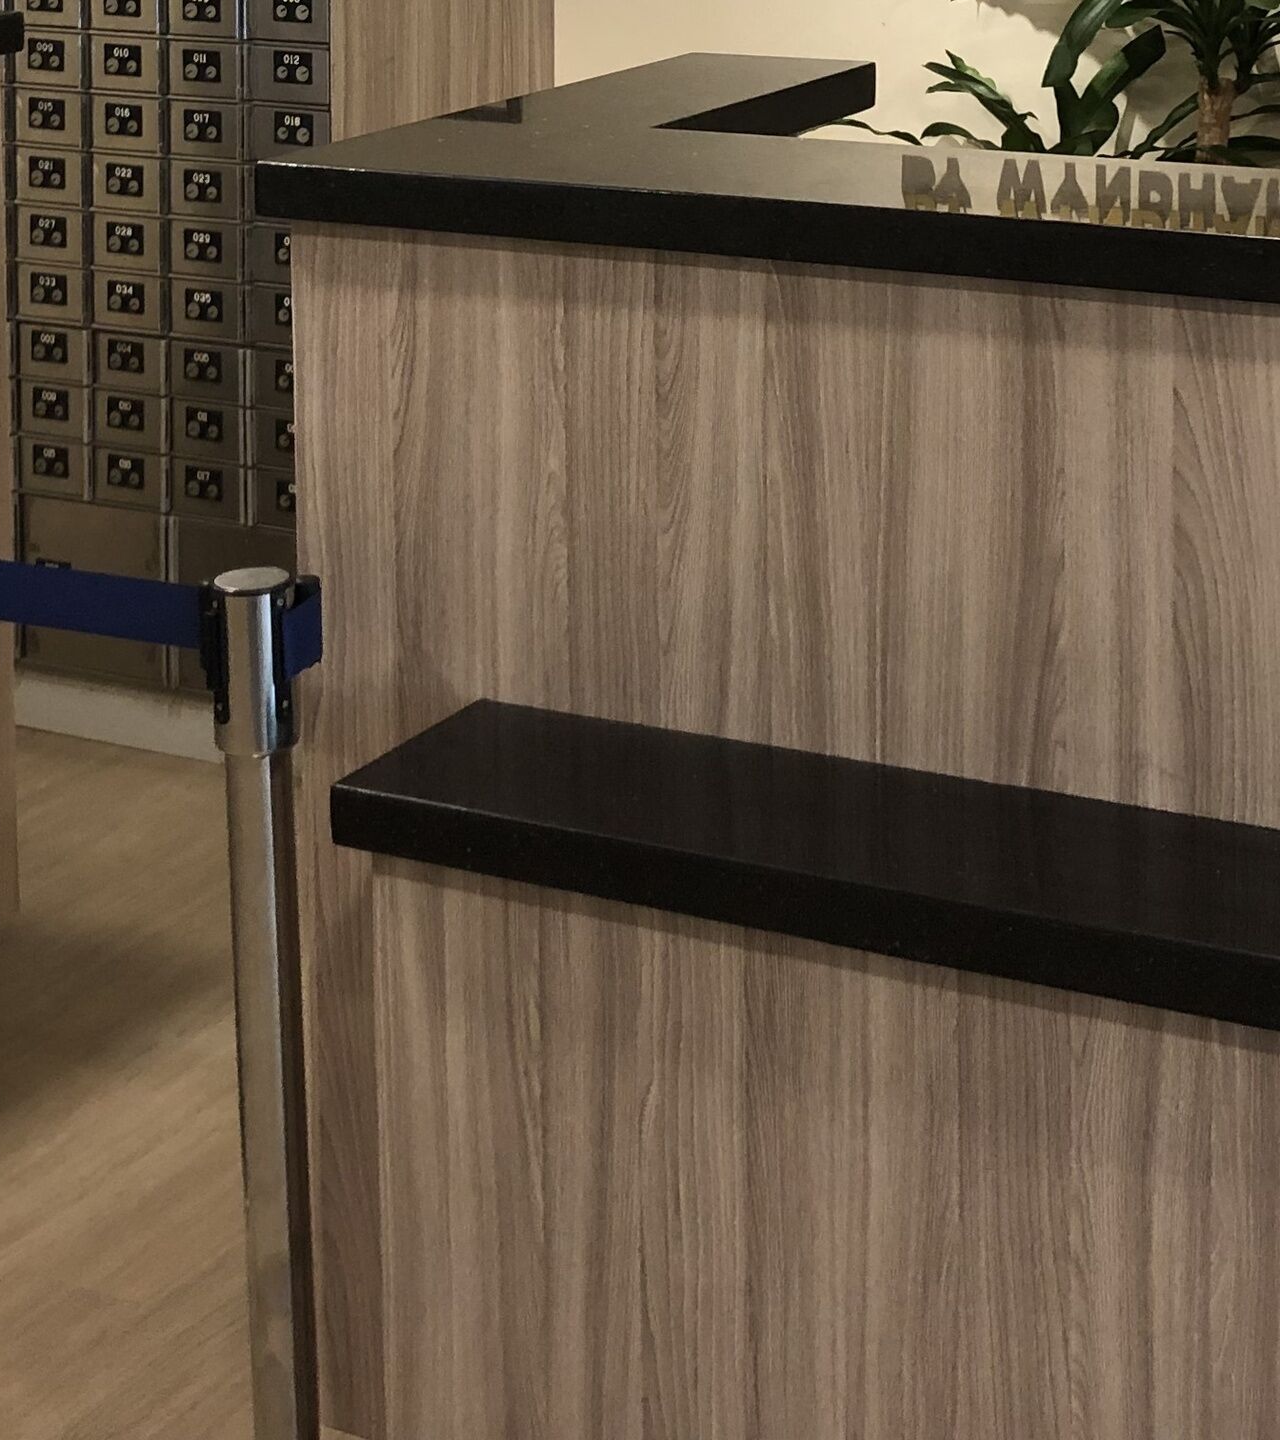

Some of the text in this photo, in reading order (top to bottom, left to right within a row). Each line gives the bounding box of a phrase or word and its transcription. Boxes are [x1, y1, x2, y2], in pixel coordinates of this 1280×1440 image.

[113, 48, 129, 58] 010
[193, 53, 207, 63] 011
[283, 54, 300, 65] 012
[193, 113, 210, 124] 017
[192, 173, 211, 184] 023
[38, 218, 56, 229] 027
[192, 232, 211, 243] 029
[116, 284, 133, 295] 034
